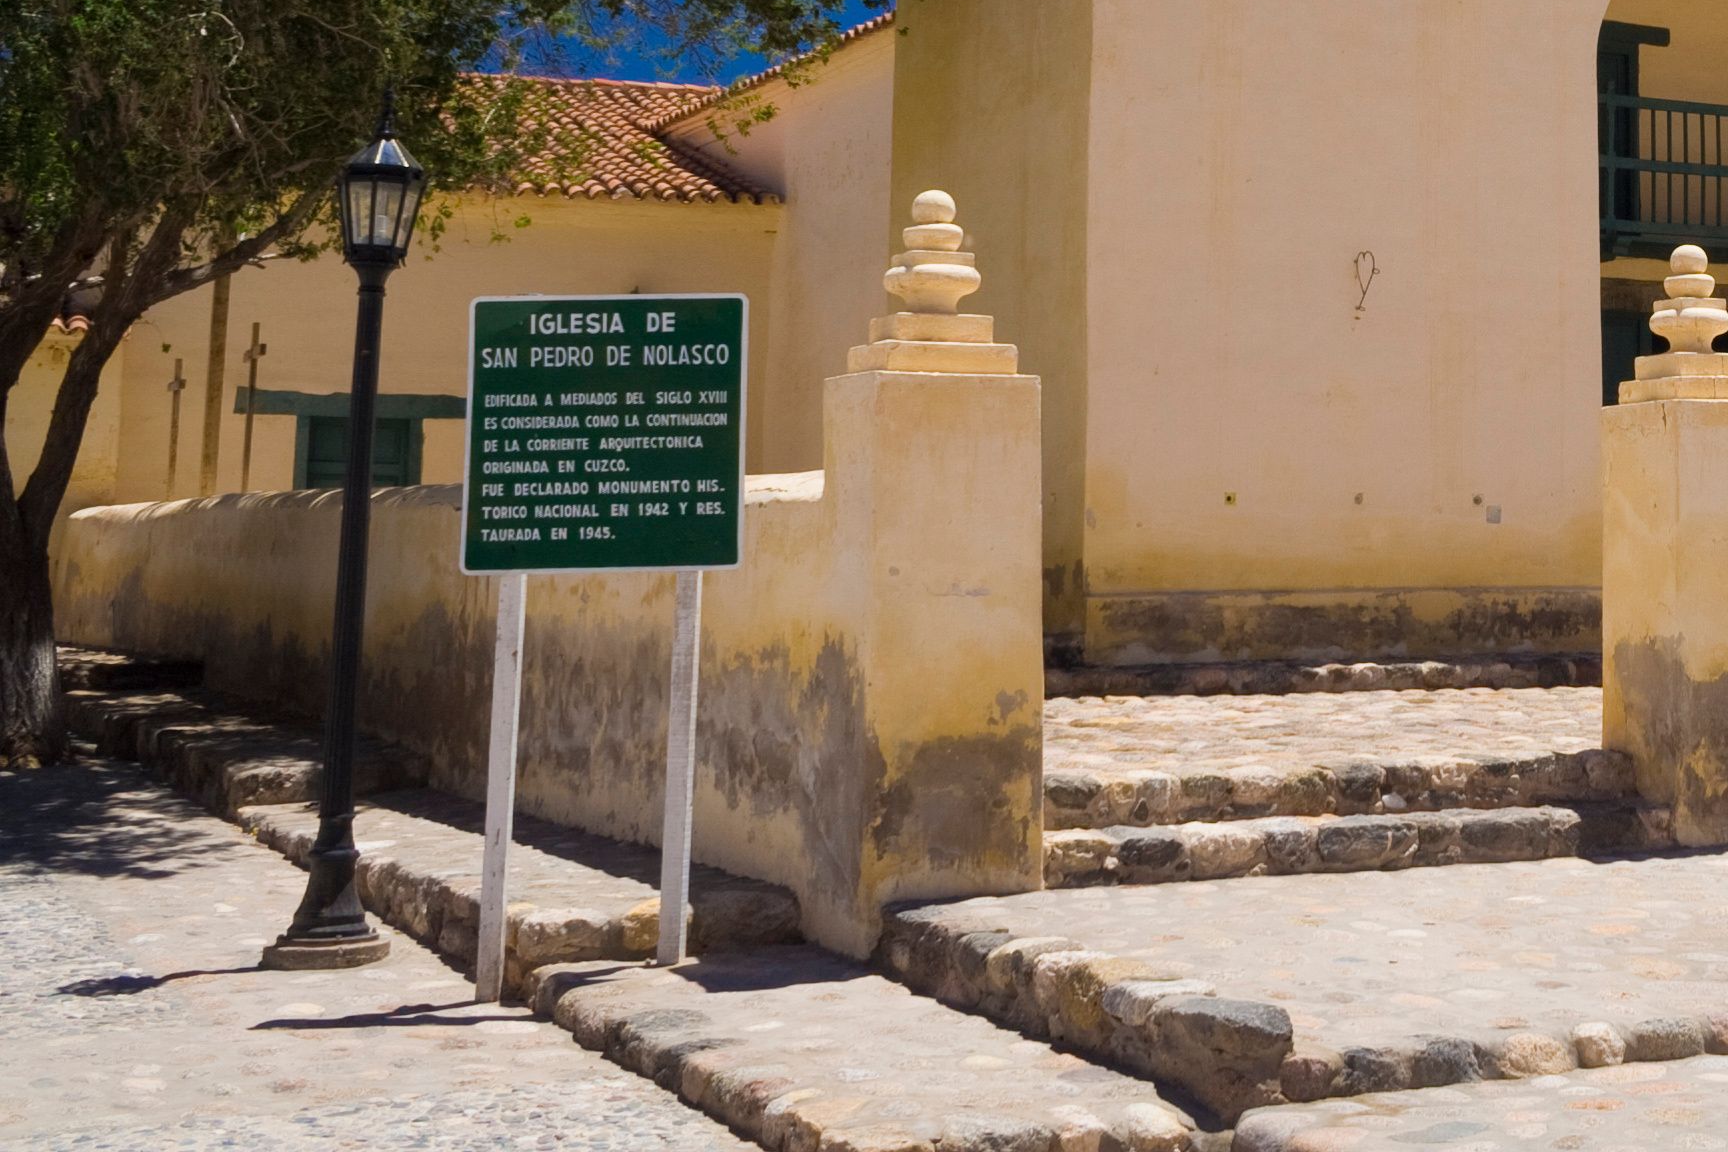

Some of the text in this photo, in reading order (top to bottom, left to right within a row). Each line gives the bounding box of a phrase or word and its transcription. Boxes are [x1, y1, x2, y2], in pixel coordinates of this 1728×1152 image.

[531, 311, 676, 335] IGLESIA DE
[481, 343, 729, 369] SAN PEDRO DE NOLASCO
[484, 390, 728, 408] EDIFICADA A MEDIADOS DEL SIGLO XVIII
[484, 413, 728, 430] ES CONSIDERADA COMO LA CONTINUACION
[483, 435, 704, 453] DE LA CORRIENTE ARQUITECTONICA
[482, 459, 630, 474] ORIGINADA EN CUZCO.
[482, 483, 504, 497] FUE
[514, 482, 589, 497] DECLARADO
[598, 480, 690, 495] MONUMENTO
[482, 505, 528, 519] TORICO
[534, 504, 600, 519] NACIONAL
[610, 503, 629, 517] EN
[638, 502, 669, 517] 1942
[679, 502, 688, 516] Y
[481, 526, 616, 542] TAURADA EN 1945.
